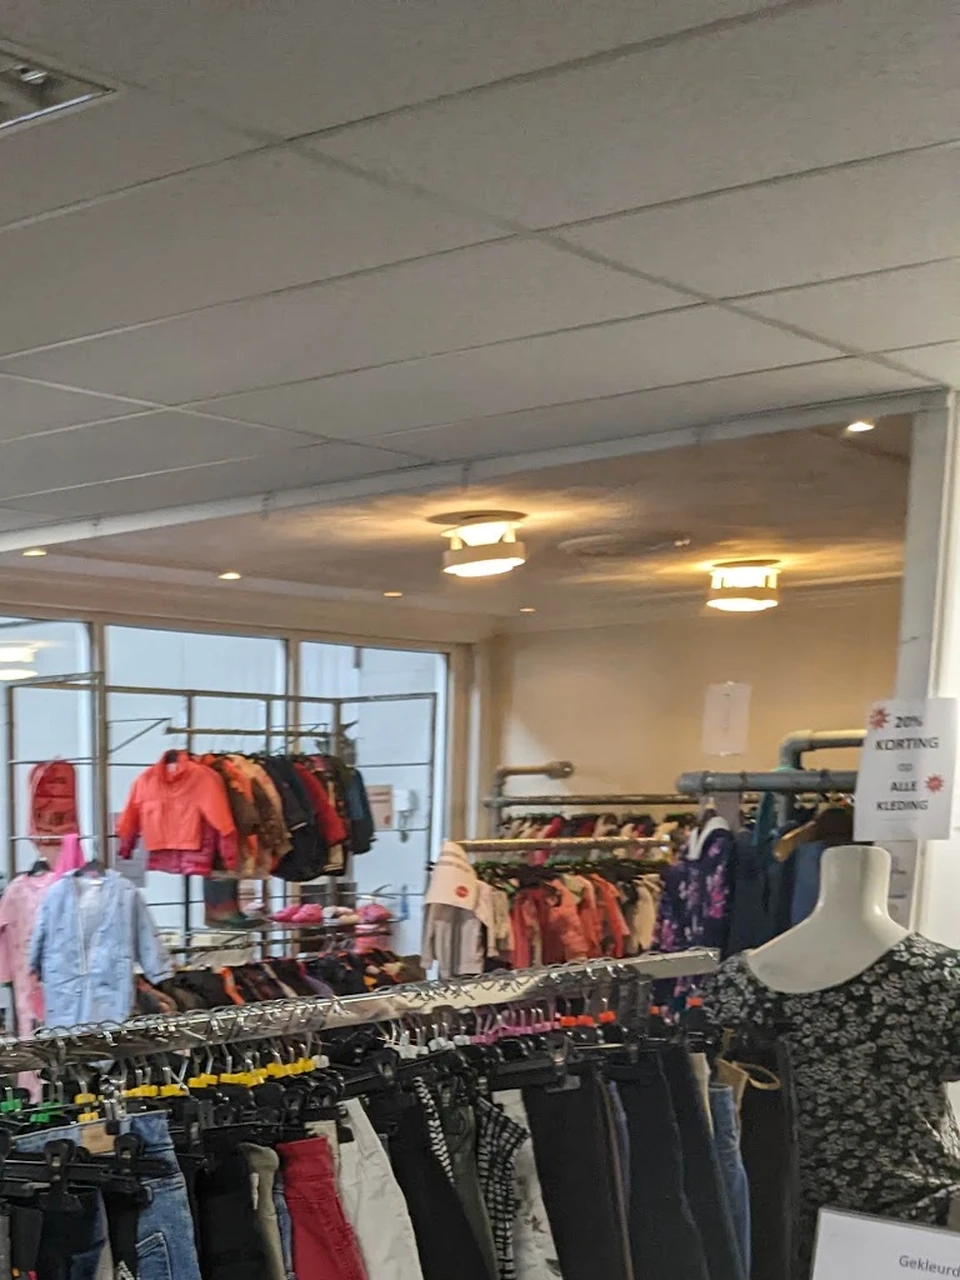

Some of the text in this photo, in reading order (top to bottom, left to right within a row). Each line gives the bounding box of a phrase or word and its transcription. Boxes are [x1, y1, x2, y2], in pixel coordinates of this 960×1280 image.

[895, 716, 923, 728] 20%
[876, 737, 939, 750] KORTING
[890, 781, 918, 792] ALLE
[876, 801, 929, 811] KLEDING
